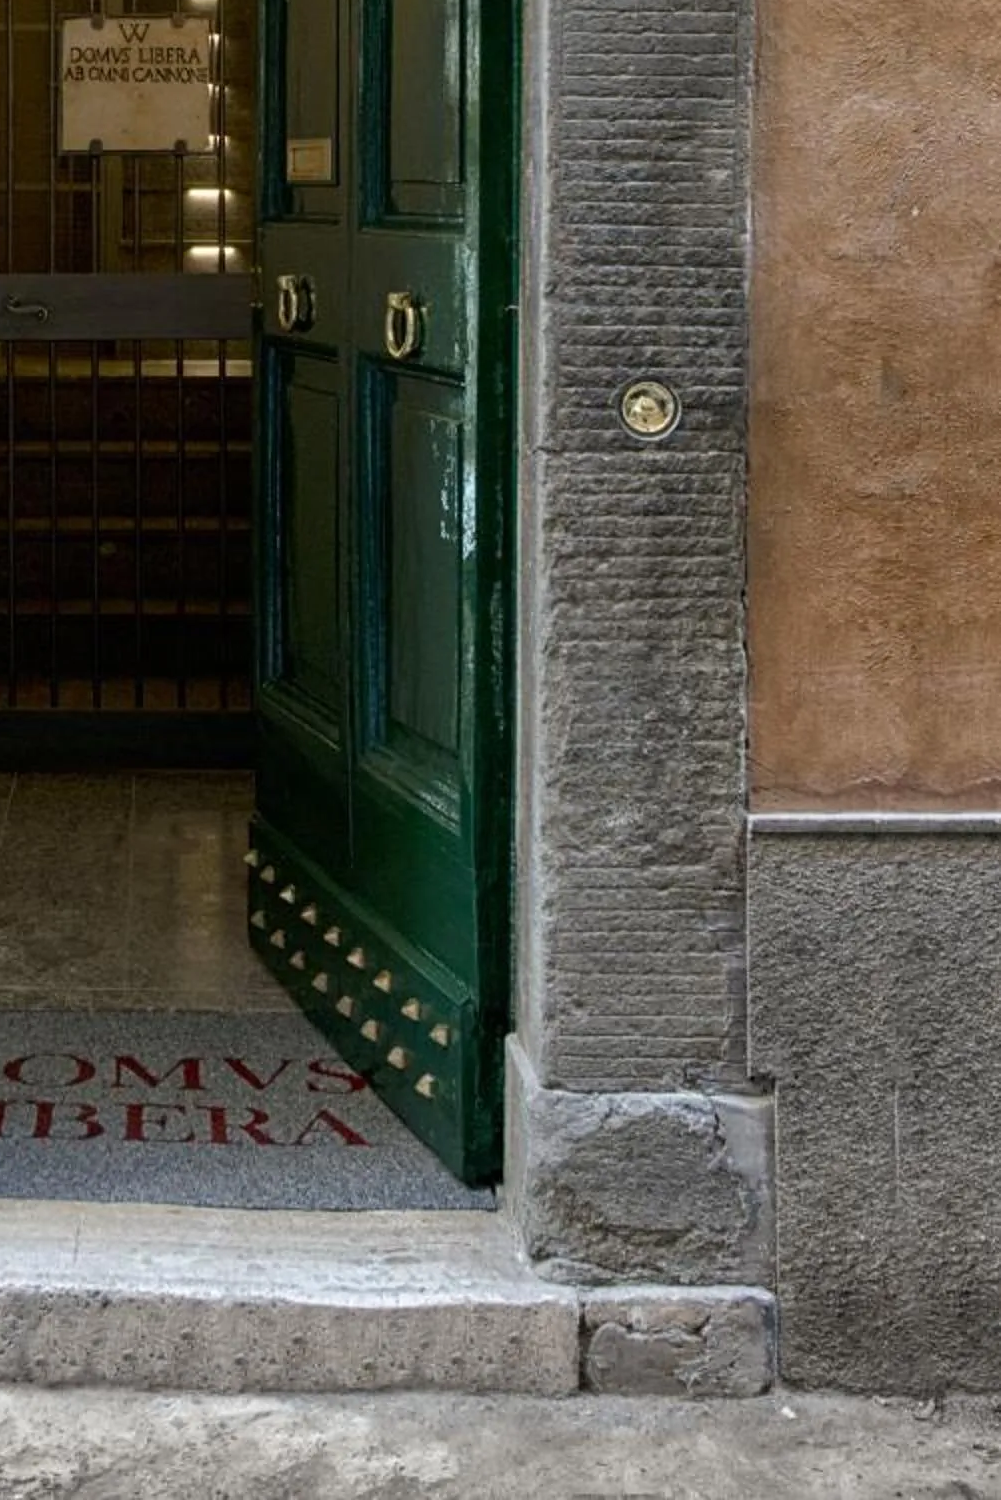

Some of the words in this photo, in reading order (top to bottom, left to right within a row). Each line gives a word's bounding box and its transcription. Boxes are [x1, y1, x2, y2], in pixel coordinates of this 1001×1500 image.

[119, 23, 150, 43] W
[70, 47, 130, 64] DOMVS
[138, 47, 202, 64] LIBERA
[64, 67, 85, 81] AB
[88, 67, 129, 82] OMNI
[132, 67, 208, 84] CANNONE
